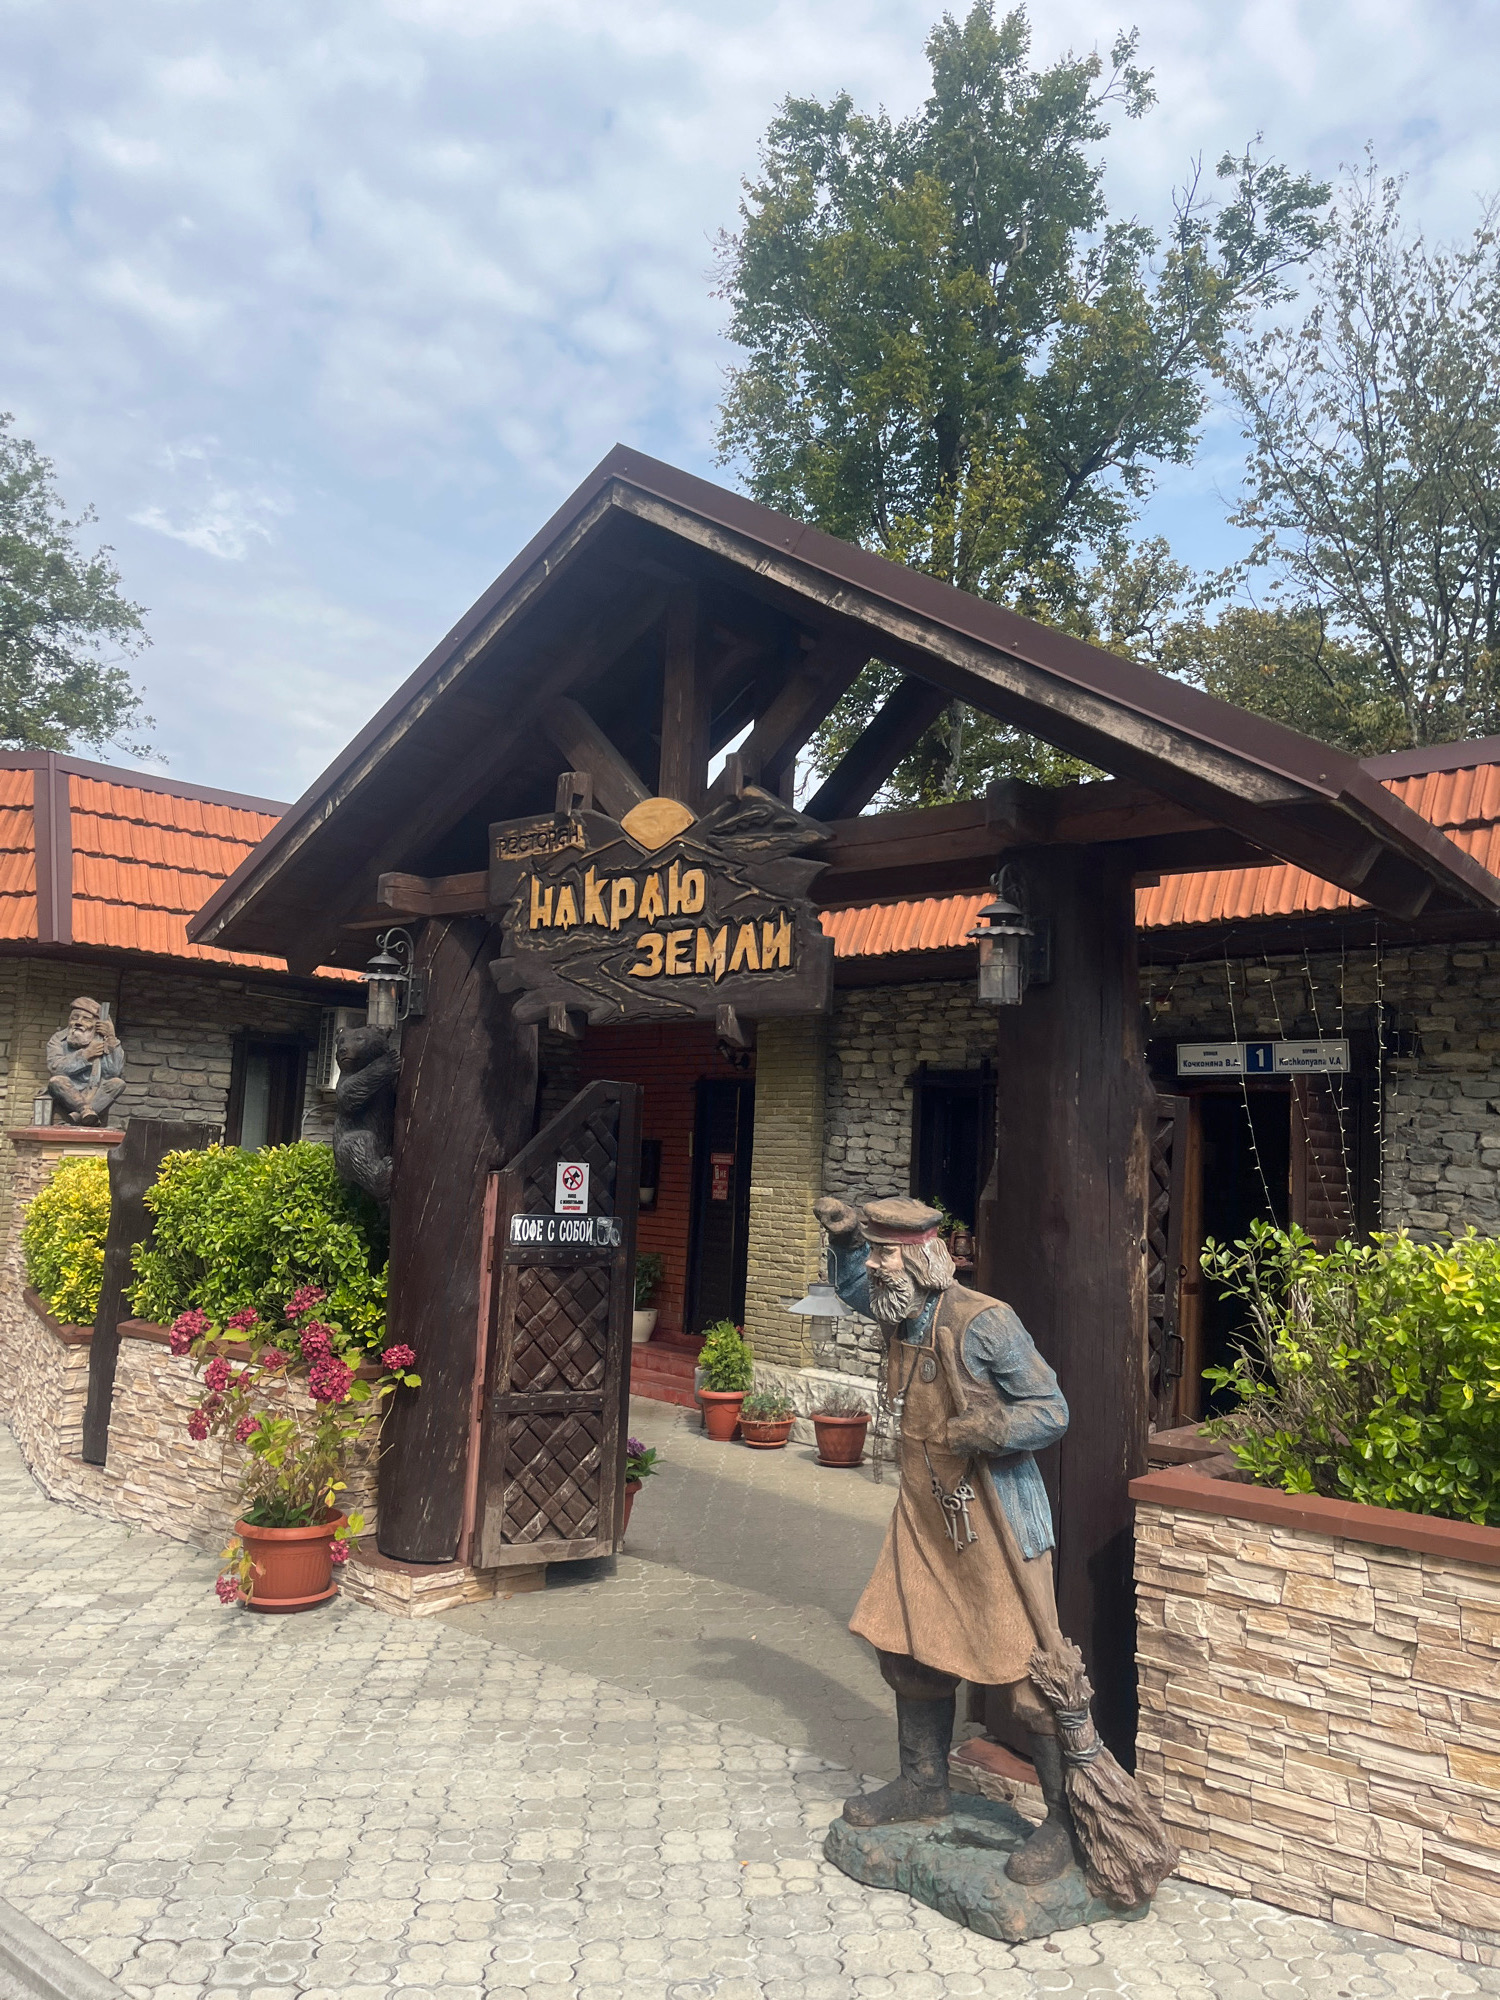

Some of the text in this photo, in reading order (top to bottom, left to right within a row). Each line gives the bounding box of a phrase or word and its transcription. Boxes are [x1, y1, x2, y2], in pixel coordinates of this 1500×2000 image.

[627, 910, 793, 983] ЗЕМЛИ
[1255, 1048, 1265, 1068] 1
[514, 1217, 594, 1242] КОФЕ С СОБОЙ
